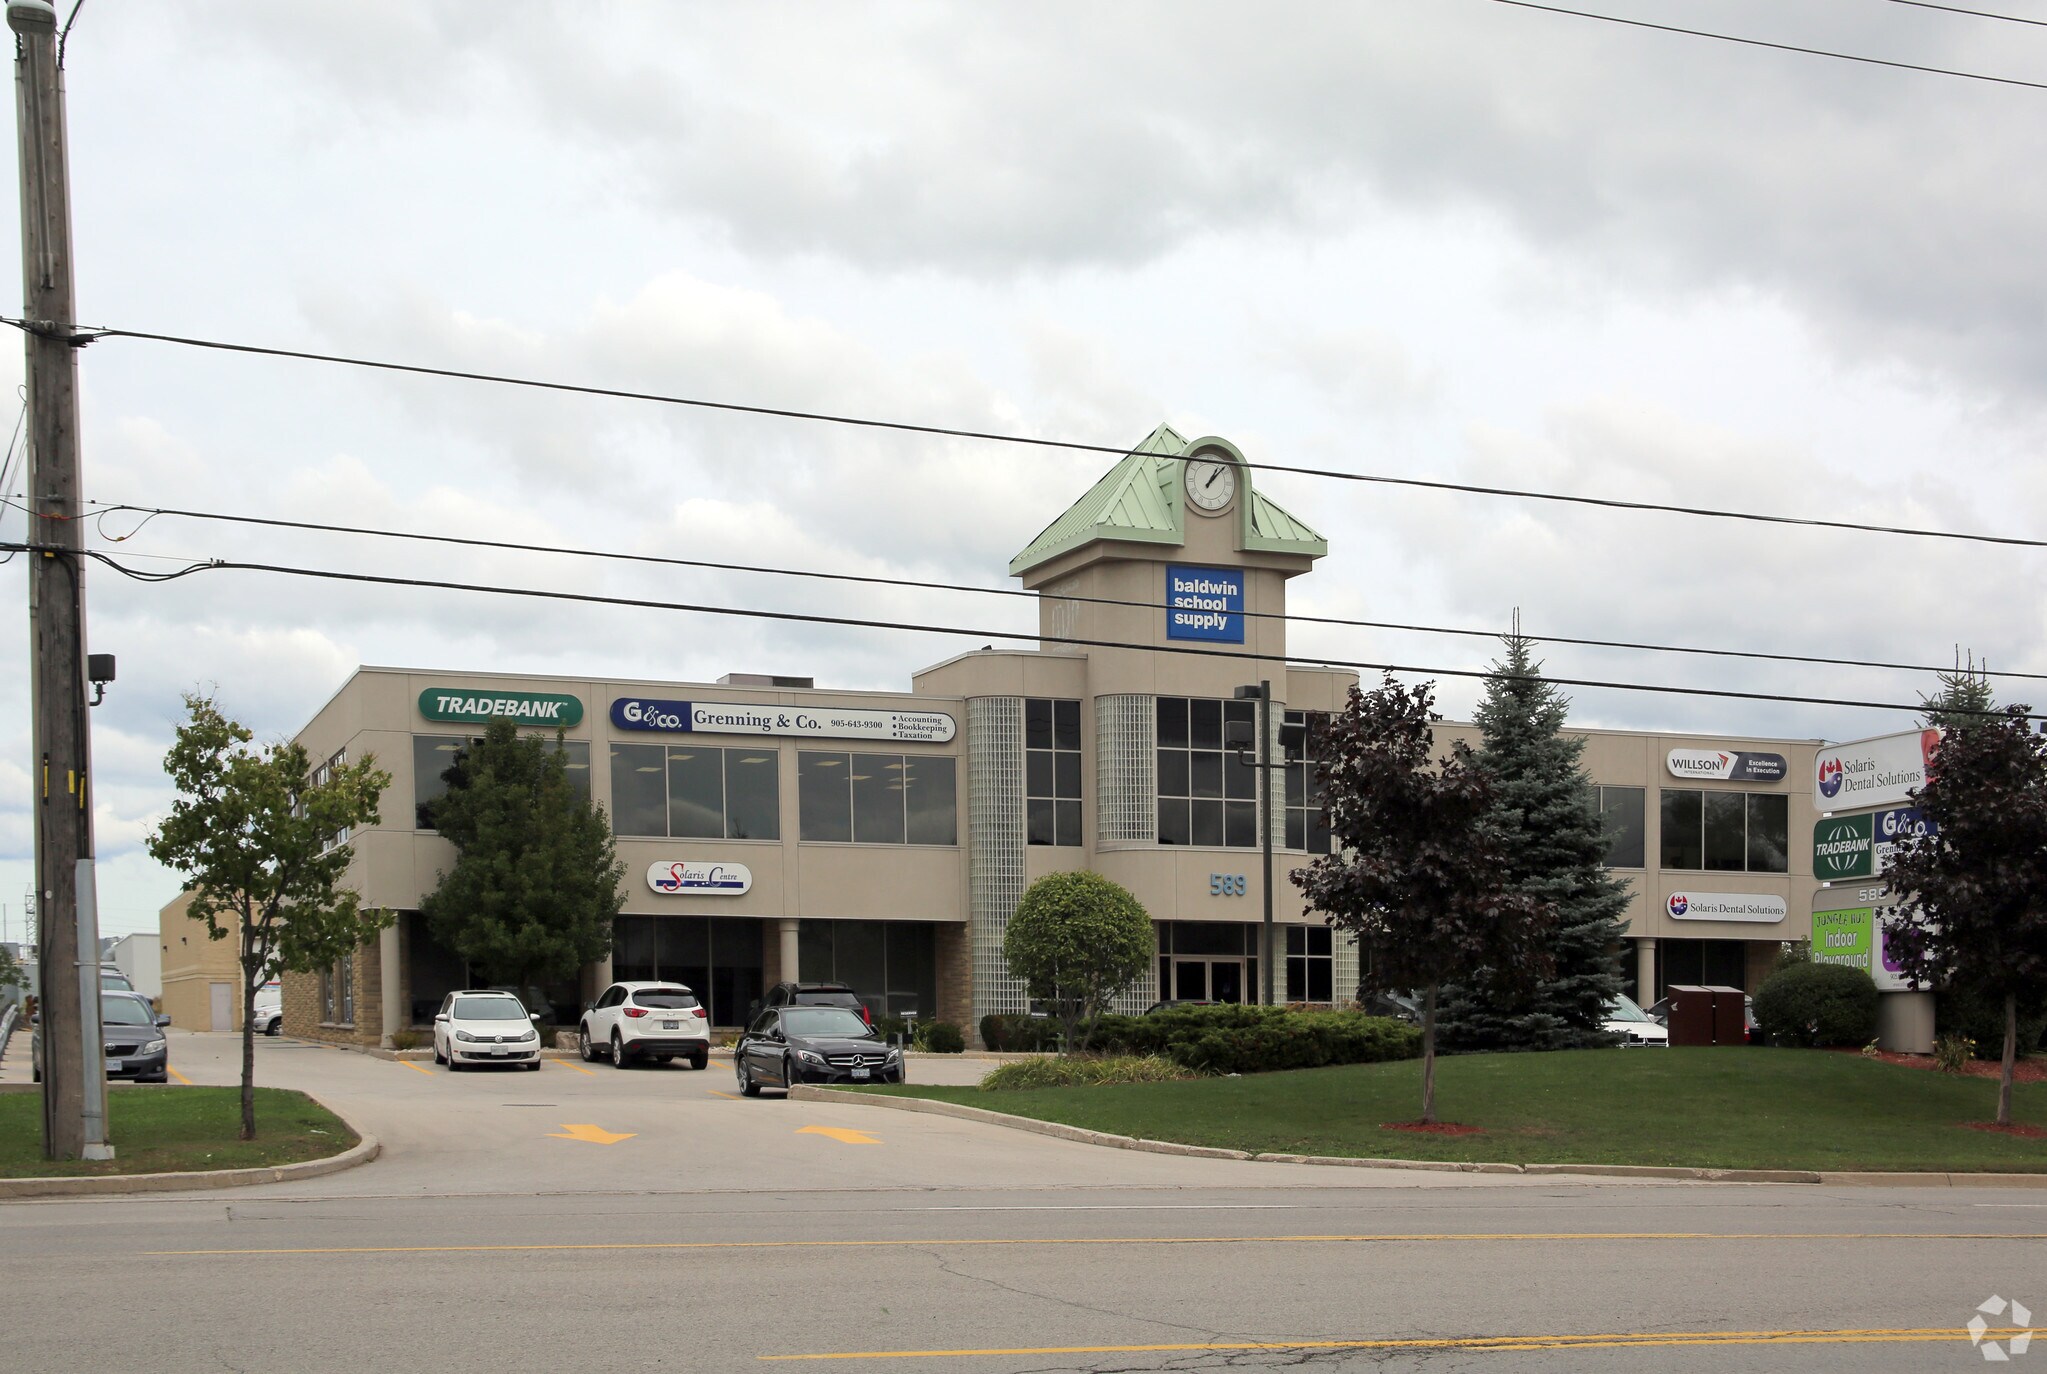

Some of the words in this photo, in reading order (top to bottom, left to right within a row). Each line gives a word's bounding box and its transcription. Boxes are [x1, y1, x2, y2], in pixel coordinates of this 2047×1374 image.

[1174, 577, 1238, 596] baldwin
[1174, 595, 1227, 611] school
[1174, 612, 1227, 631] supply
[436, 696, 562, 718] TRADEBANK
[694, 709, 772, 732] Grenning
[776, 714, 790, 728] &
[796, 714, 822, 730] Co.
[830, 719, 883, 729] 905-643-9300
[898, 715, 942, 725] Accounting
[898, 723, 948, 733] Bookkeeping
[898, 731, 933, 740] Taxation
[1672, 758, 1720, 771] WILLSON
[1748, 759, 1778, 768] Excellence
[1753, 766, 1780, 775] Execution
[1844, 757, 1875, 775] Solaris
[1844, 774, 1875, 793] Dental
[1876, 770, 1921, 788] Solutions
[1816, 838, 1871, 856] TRADEBANK
[663, 863, 704, 891] Solaris
[708, 866, 737, 887] Centre
[1210, 873, 1247, 896] 589
[1690, 902, 1718, 914] Solaris
[1719, 904, 1746, 914] Dental
[1747, 905, 1785, 915] Solutions
[1825, 928, 1858, 948] Indoor
